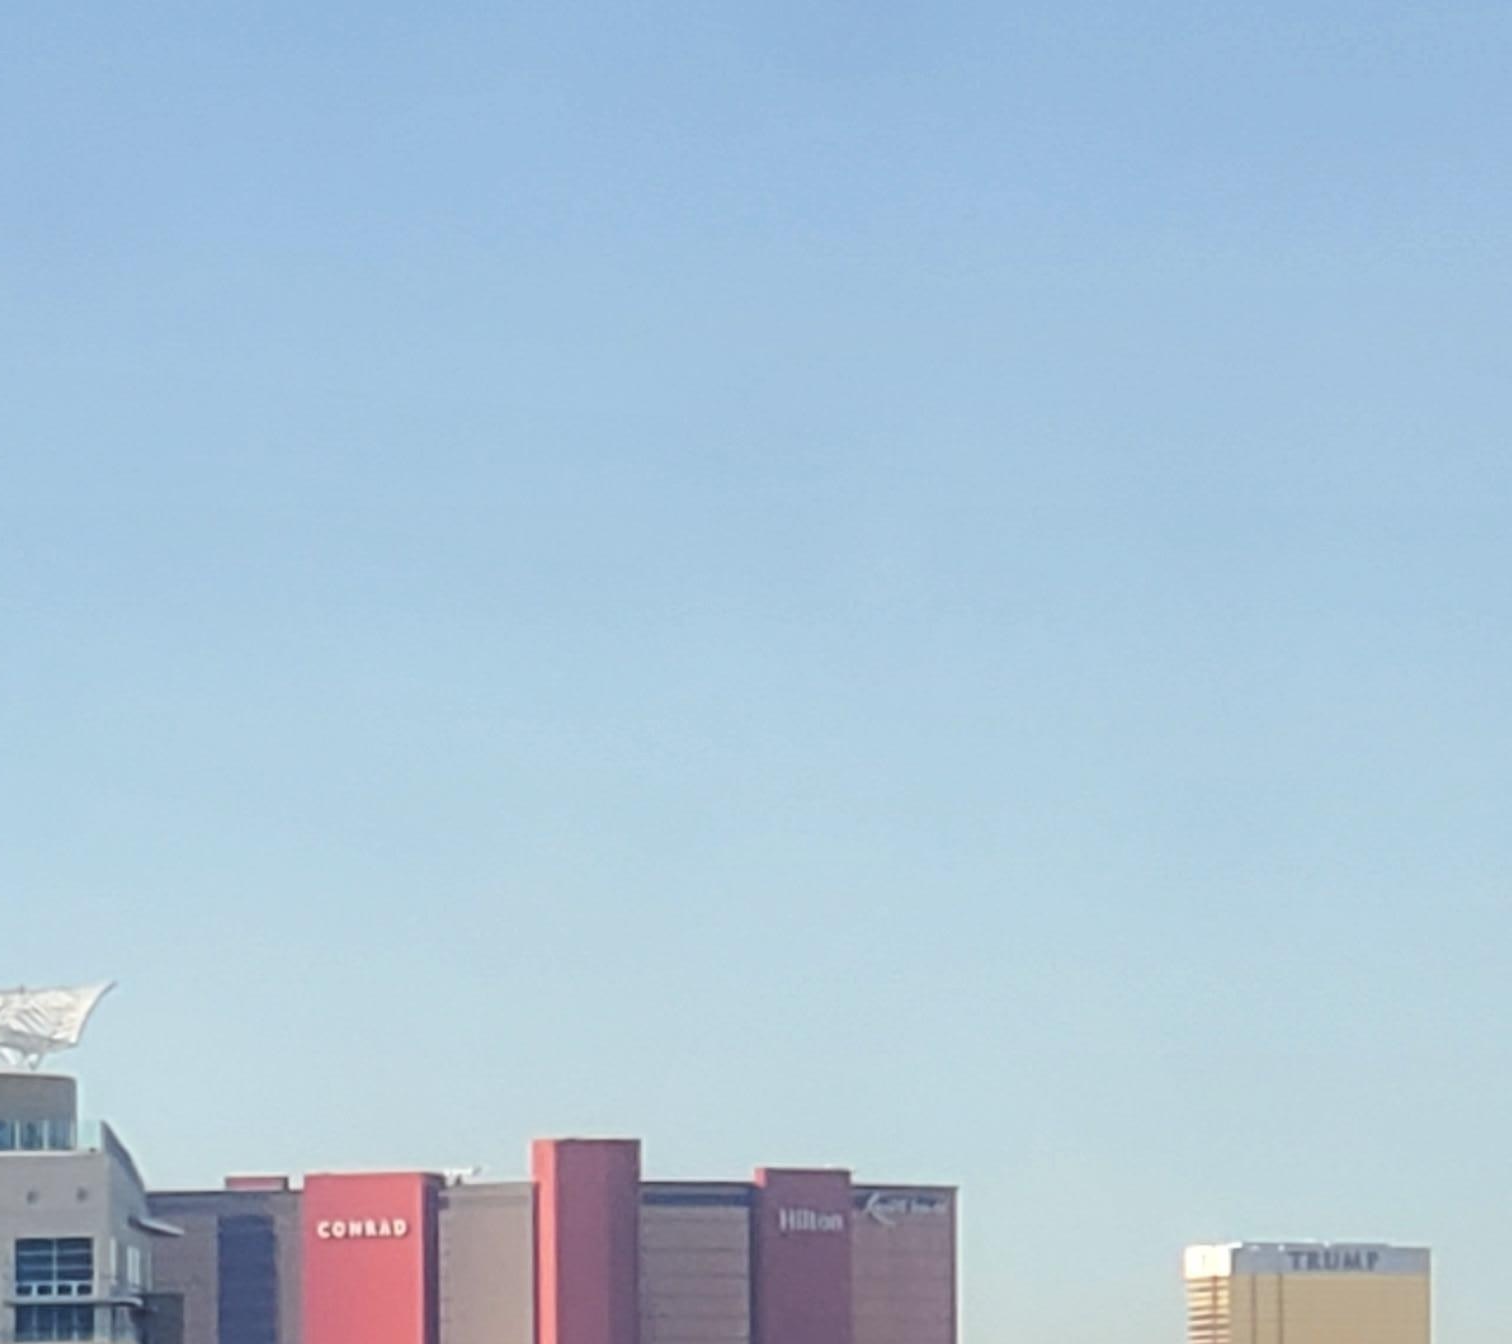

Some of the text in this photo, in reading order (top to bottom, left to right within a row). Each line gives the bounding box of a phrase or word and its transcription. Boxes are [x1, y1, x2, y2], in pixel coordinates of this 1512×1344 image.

[317, 1218, 407, 1238] CONRAD
[779, 1208, 843, 1231] Hilton
[1288, 1250, 1379, 1271] TRUMP
